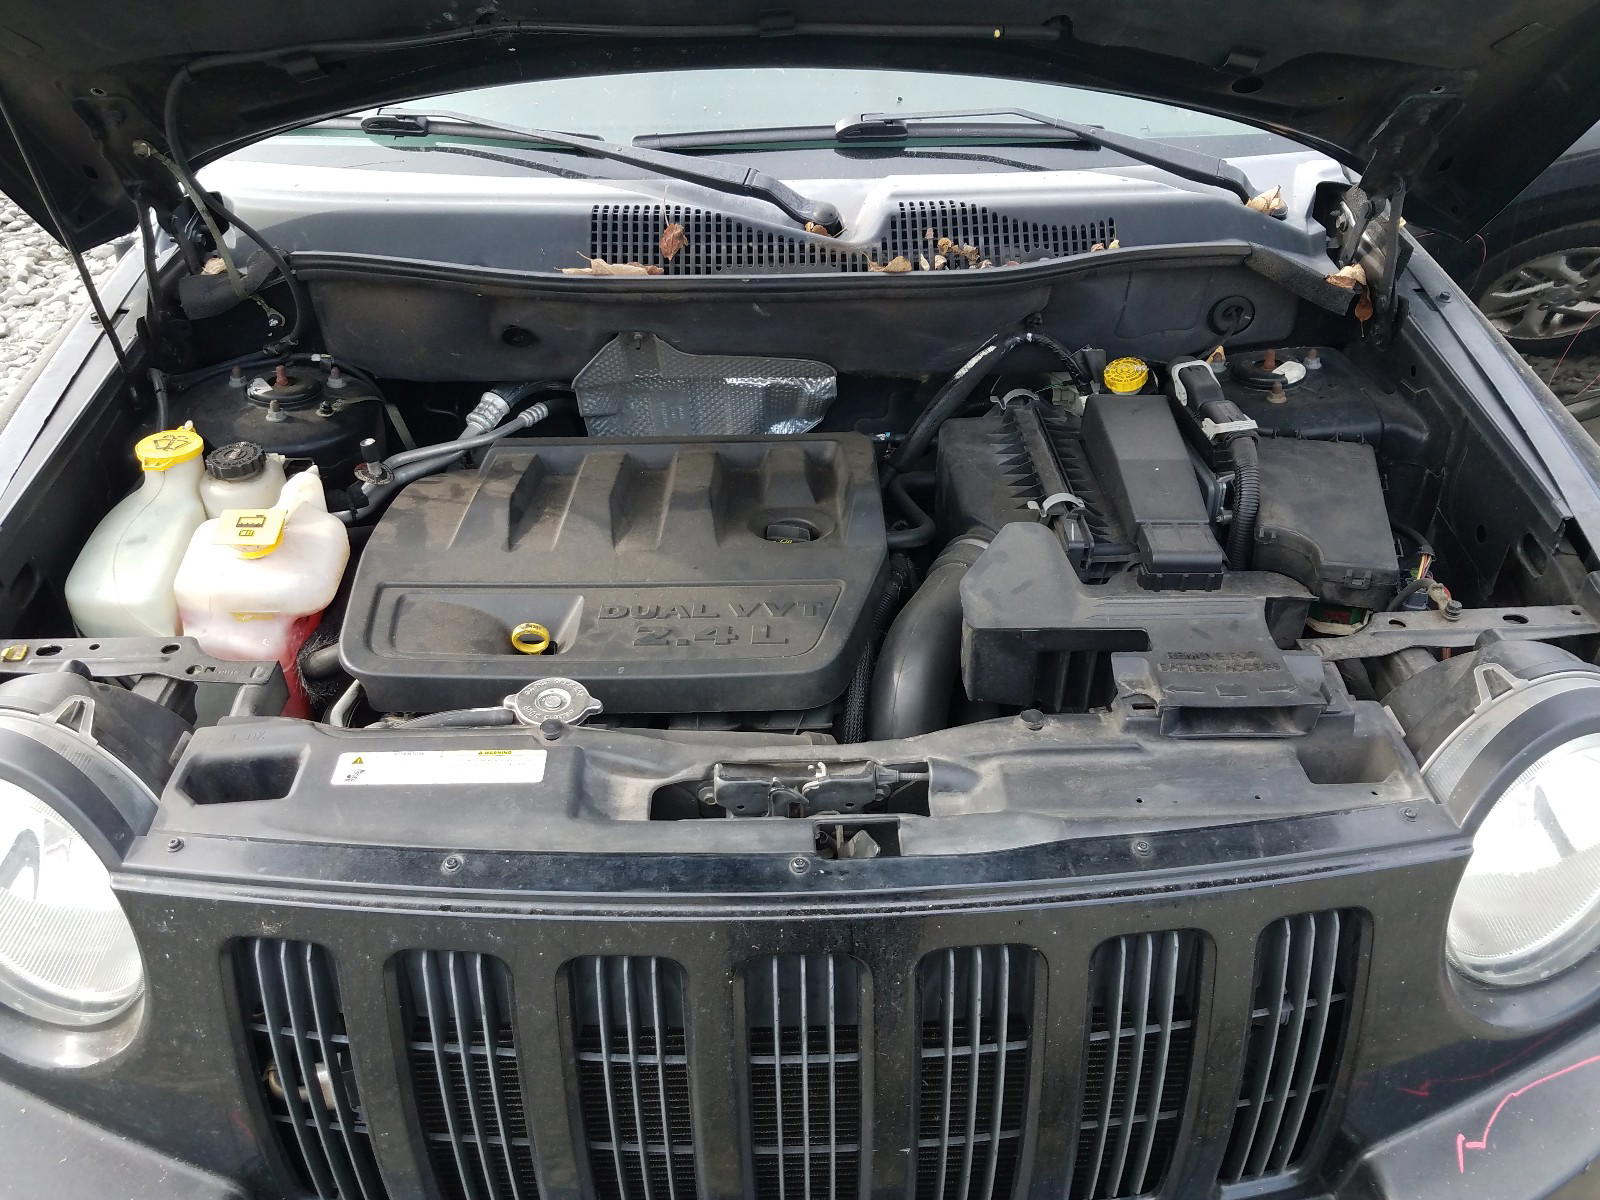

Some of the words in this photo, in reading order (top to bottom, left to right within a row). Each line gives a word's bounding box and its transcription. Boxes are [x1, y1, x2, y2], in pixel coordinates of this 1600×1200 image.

[598, 601, 721, 619] DUAL
[727, 600, 823, 618] VVT
[1158, 663, 1219, 673] BATTERY
